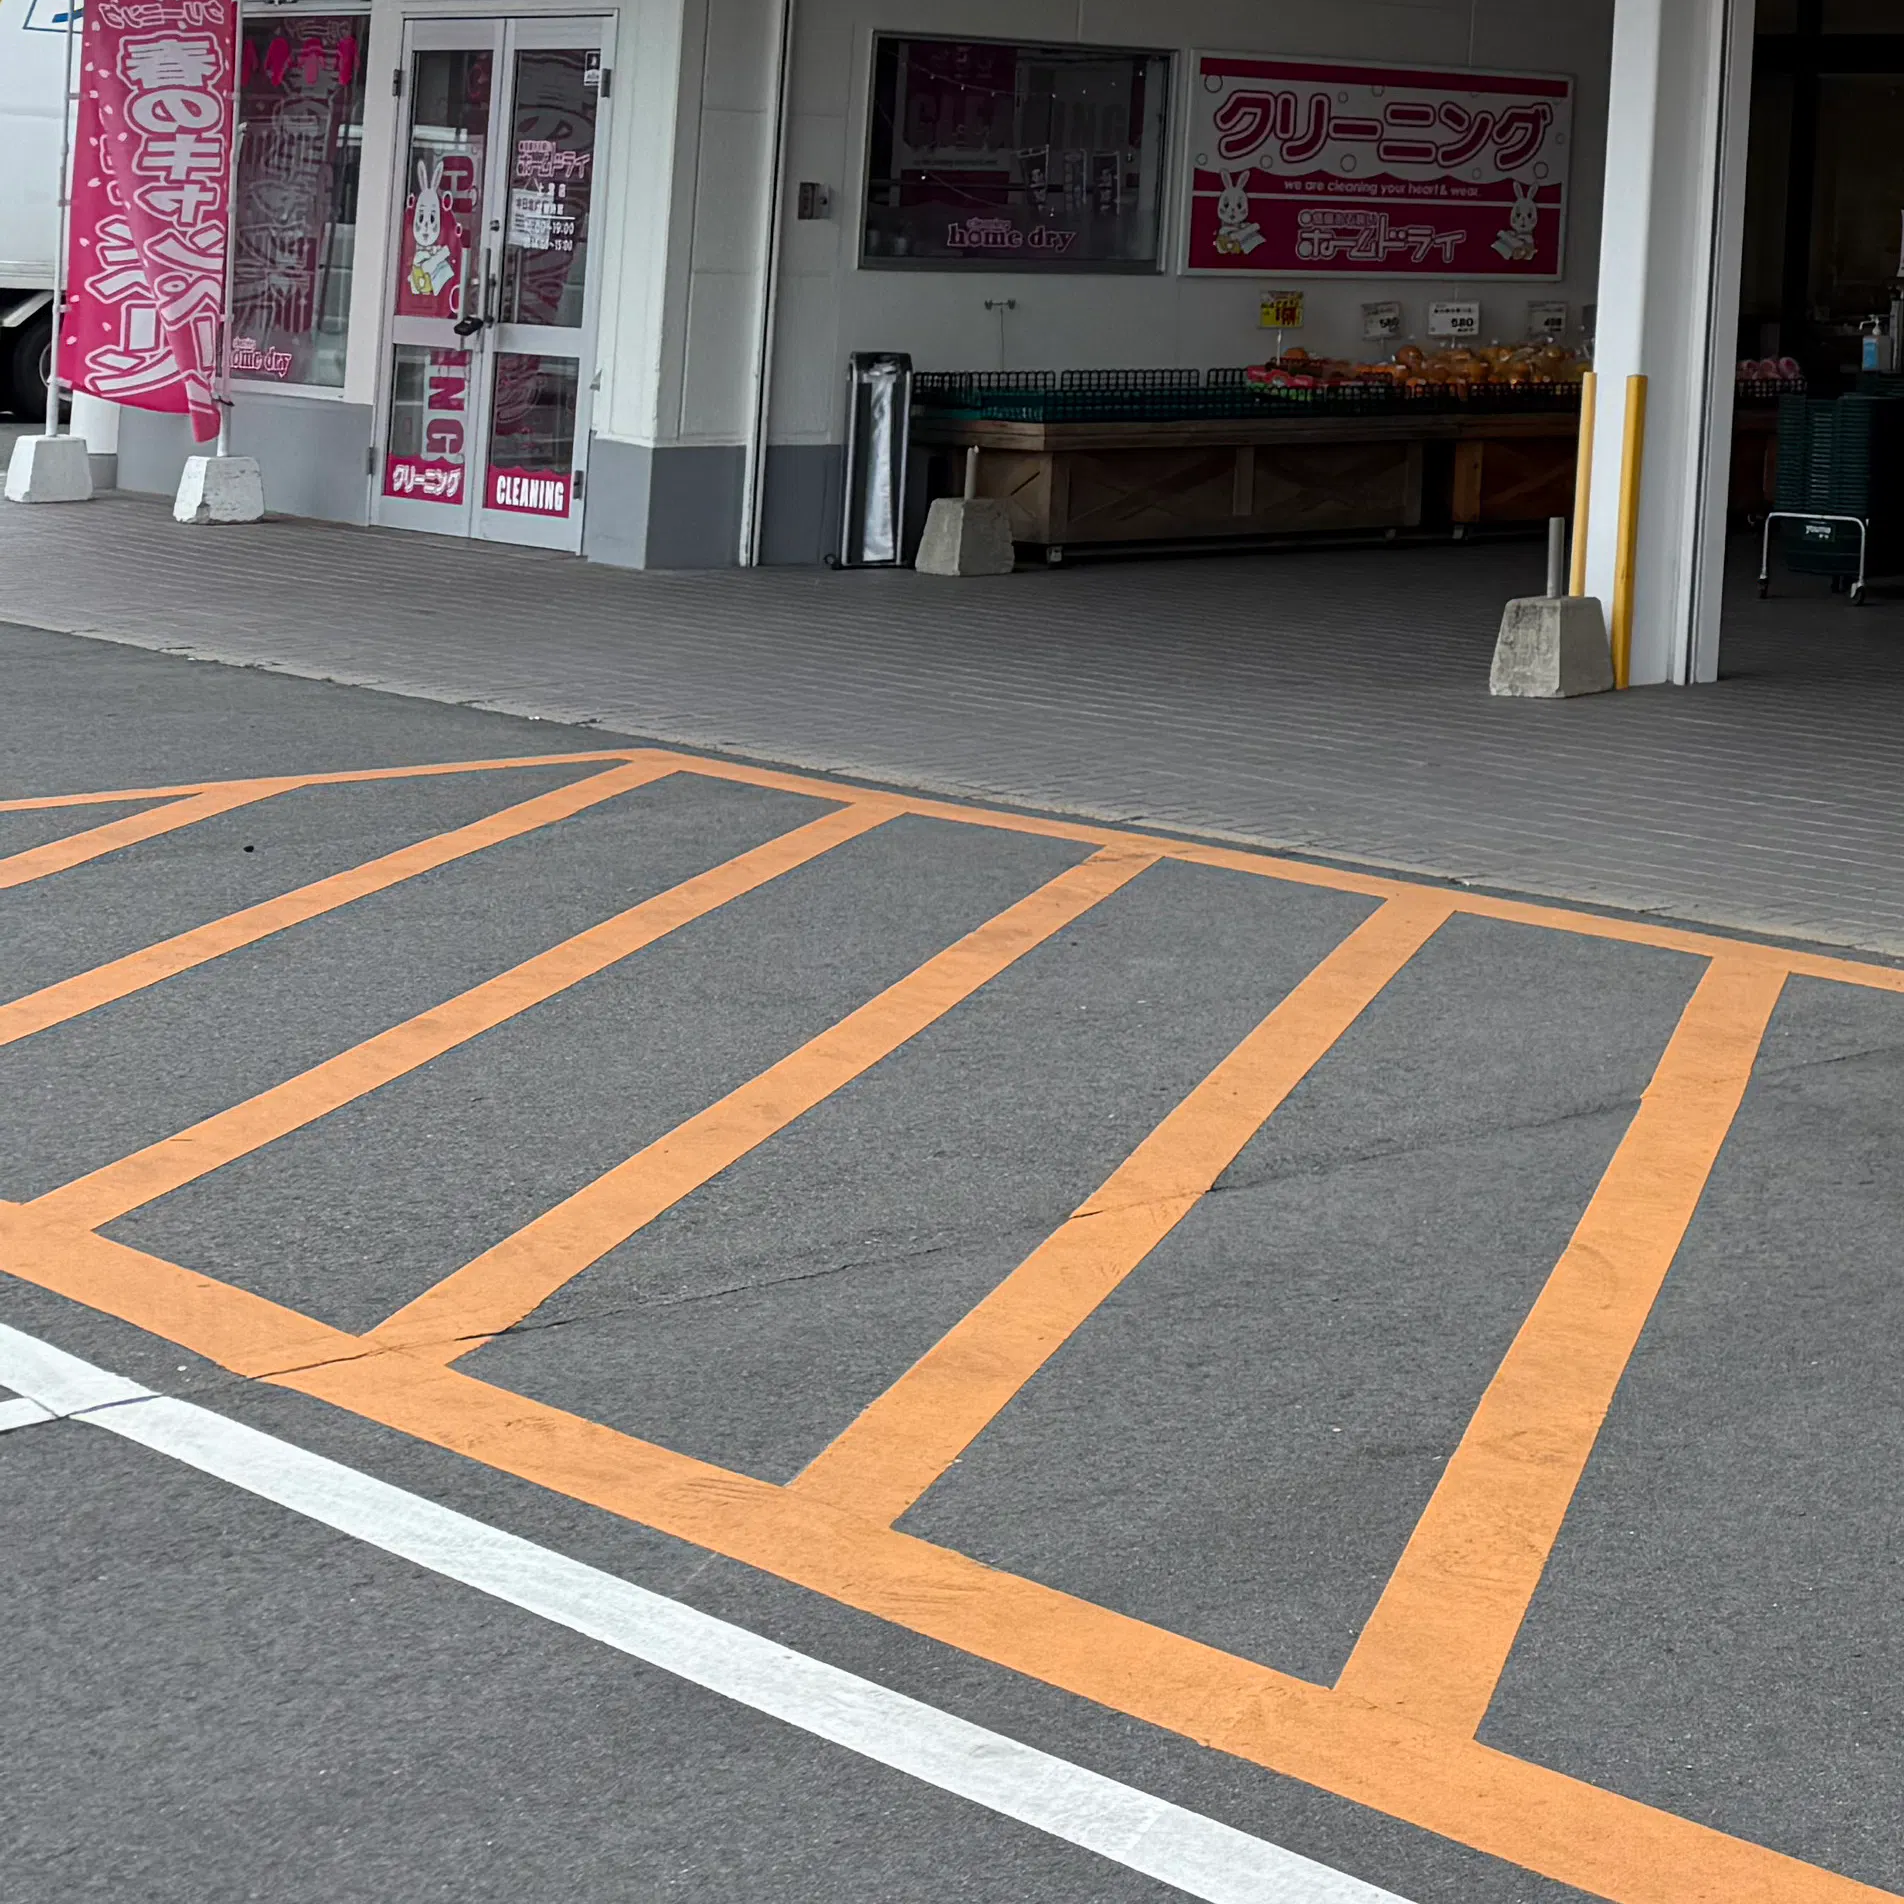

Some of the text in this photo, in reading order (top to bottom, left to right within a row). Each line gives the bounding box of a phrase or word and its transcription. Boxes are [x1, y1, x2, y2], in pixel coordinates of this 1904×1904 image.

[1213, 89, 1553, 172] クリーニング
[1284, 180, 1301, 191] we
[1304, 182, 1324, 192] are
[1327, 179, 1378, 196] cleaning
[1380, 184, 1406, 198] your
[1408, 182, 1439, 195] heart
[947, 223, 1077, 253] home dry
[1296, 213, 1467, 263] ホームドライ
[392, 463, 461, 498] クリーニング
[495, 475, 565, 512] CLEANING
